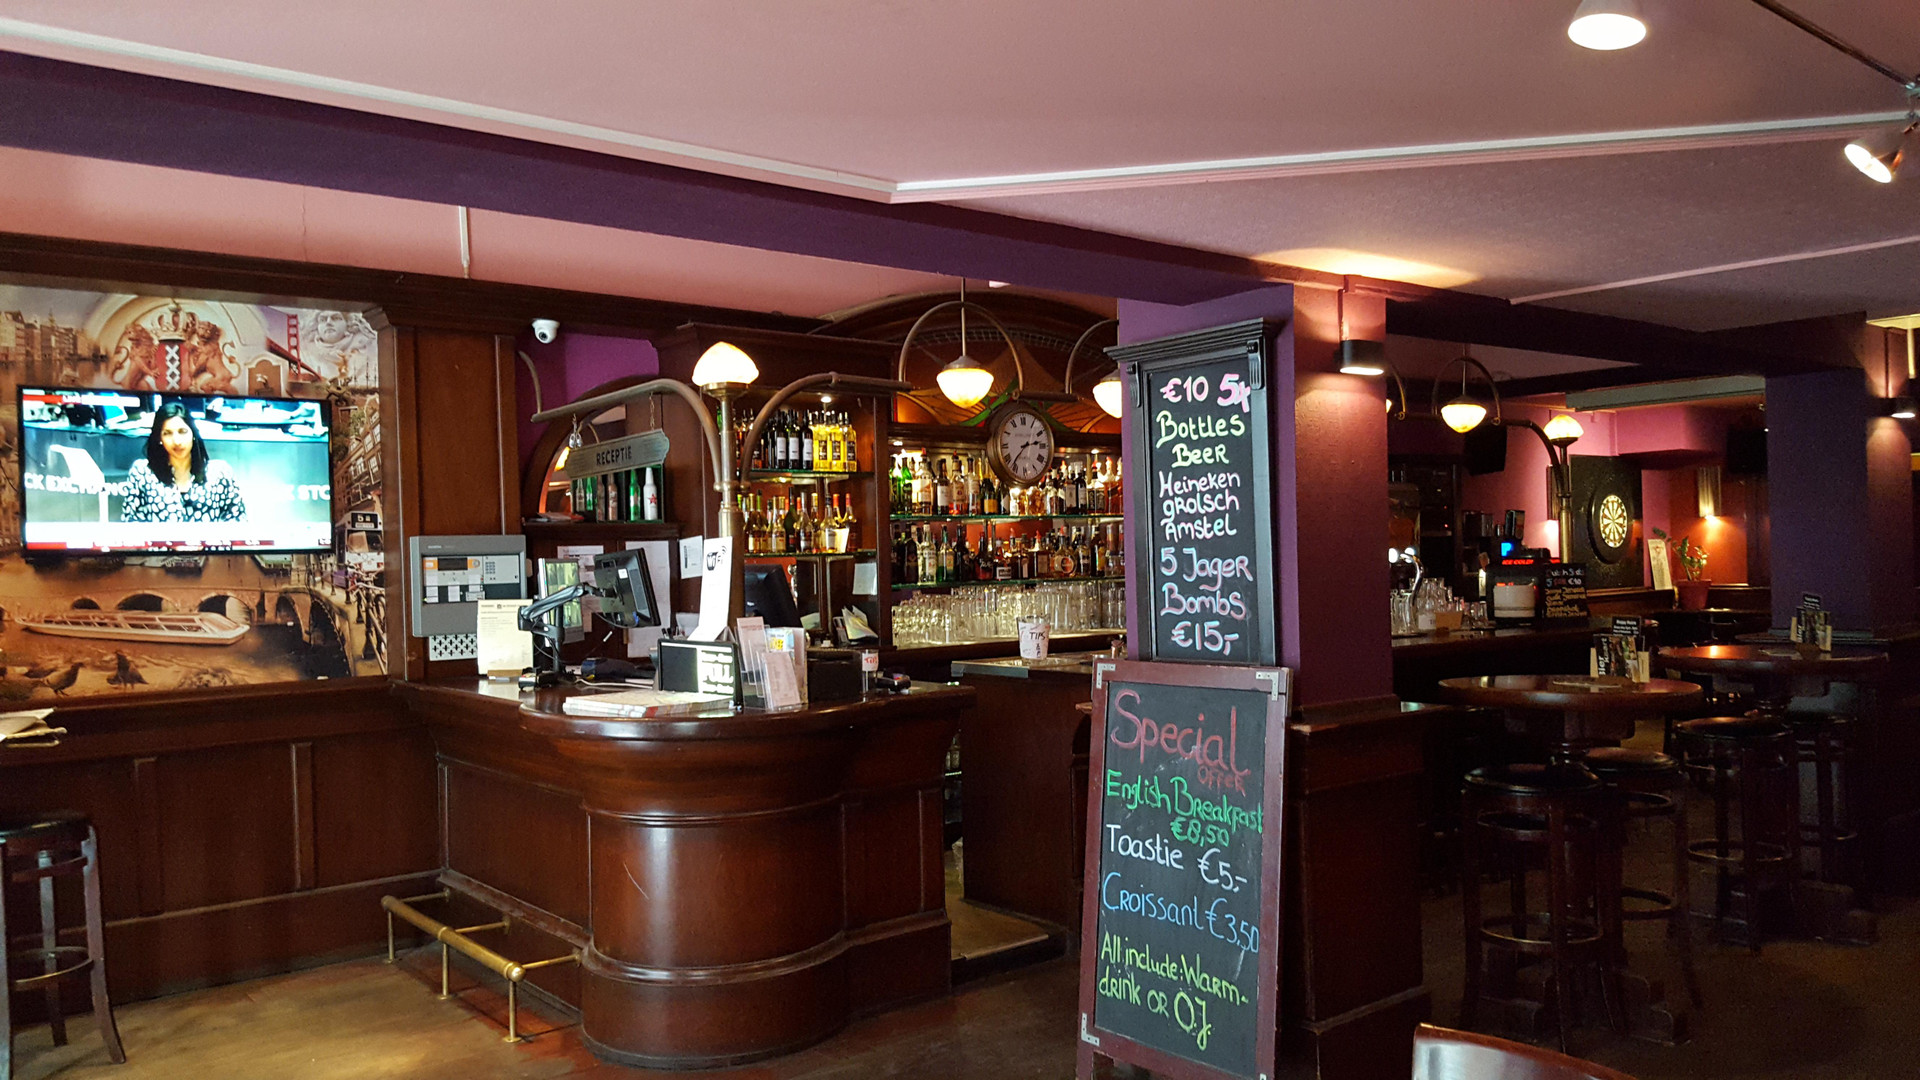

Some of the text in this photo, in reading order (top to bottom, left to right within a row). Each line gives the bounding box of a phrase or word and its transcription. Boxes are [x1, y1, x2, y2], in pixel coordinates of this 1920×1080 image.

[1160, 375, 1209, 403] €10
[1156, 410, 1246, 448] Bottles
[596, 445, 632, 466] RECEPTIE
[1158, 470, 1241, 498] Heineken
[1165, 513, 1238, 543] Amstel
[1160, 547, 1178, 576] 5
[1160, 582, 1246, 621] Bombs
[1110, 689, 1251, 776] Special
[1106, 768, 1264, 834] English Breakfast
[1106, 824, 1185, 870] Toastie
[1101, 931, 1122, 964] All
[1098, 965, 1142, 1006] drink
